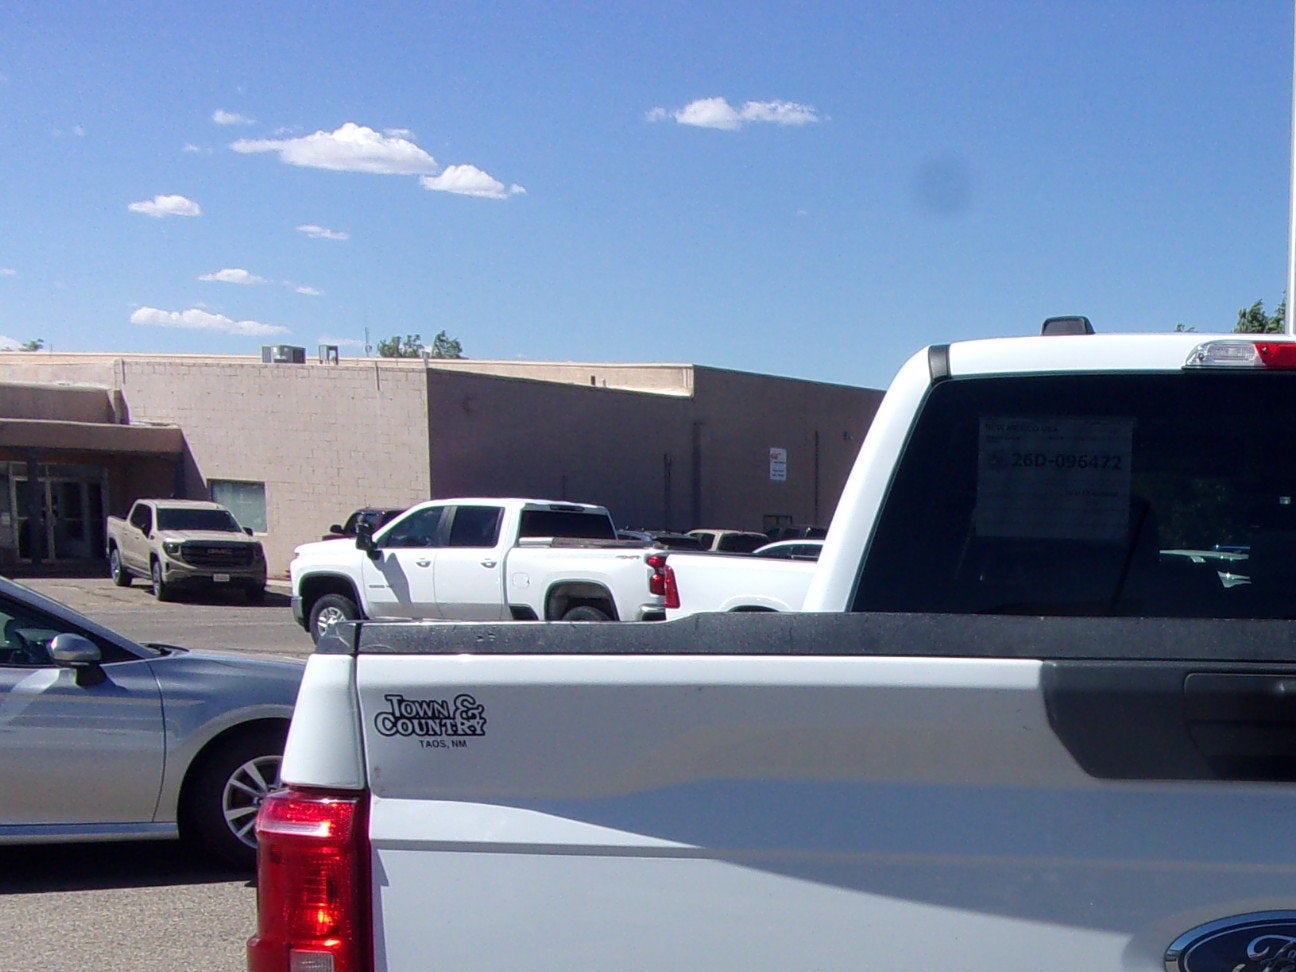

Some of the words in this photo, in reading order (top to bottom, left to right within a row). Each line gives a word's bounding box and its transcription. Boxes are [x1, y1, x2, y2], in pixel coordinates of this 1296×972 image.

[1011, 452, 1122, 471] 26D-096472
[453, 694, 485, 720] &
[419, 740, 450, 749] TAOS,
[451, 740, 468, 748] NM
